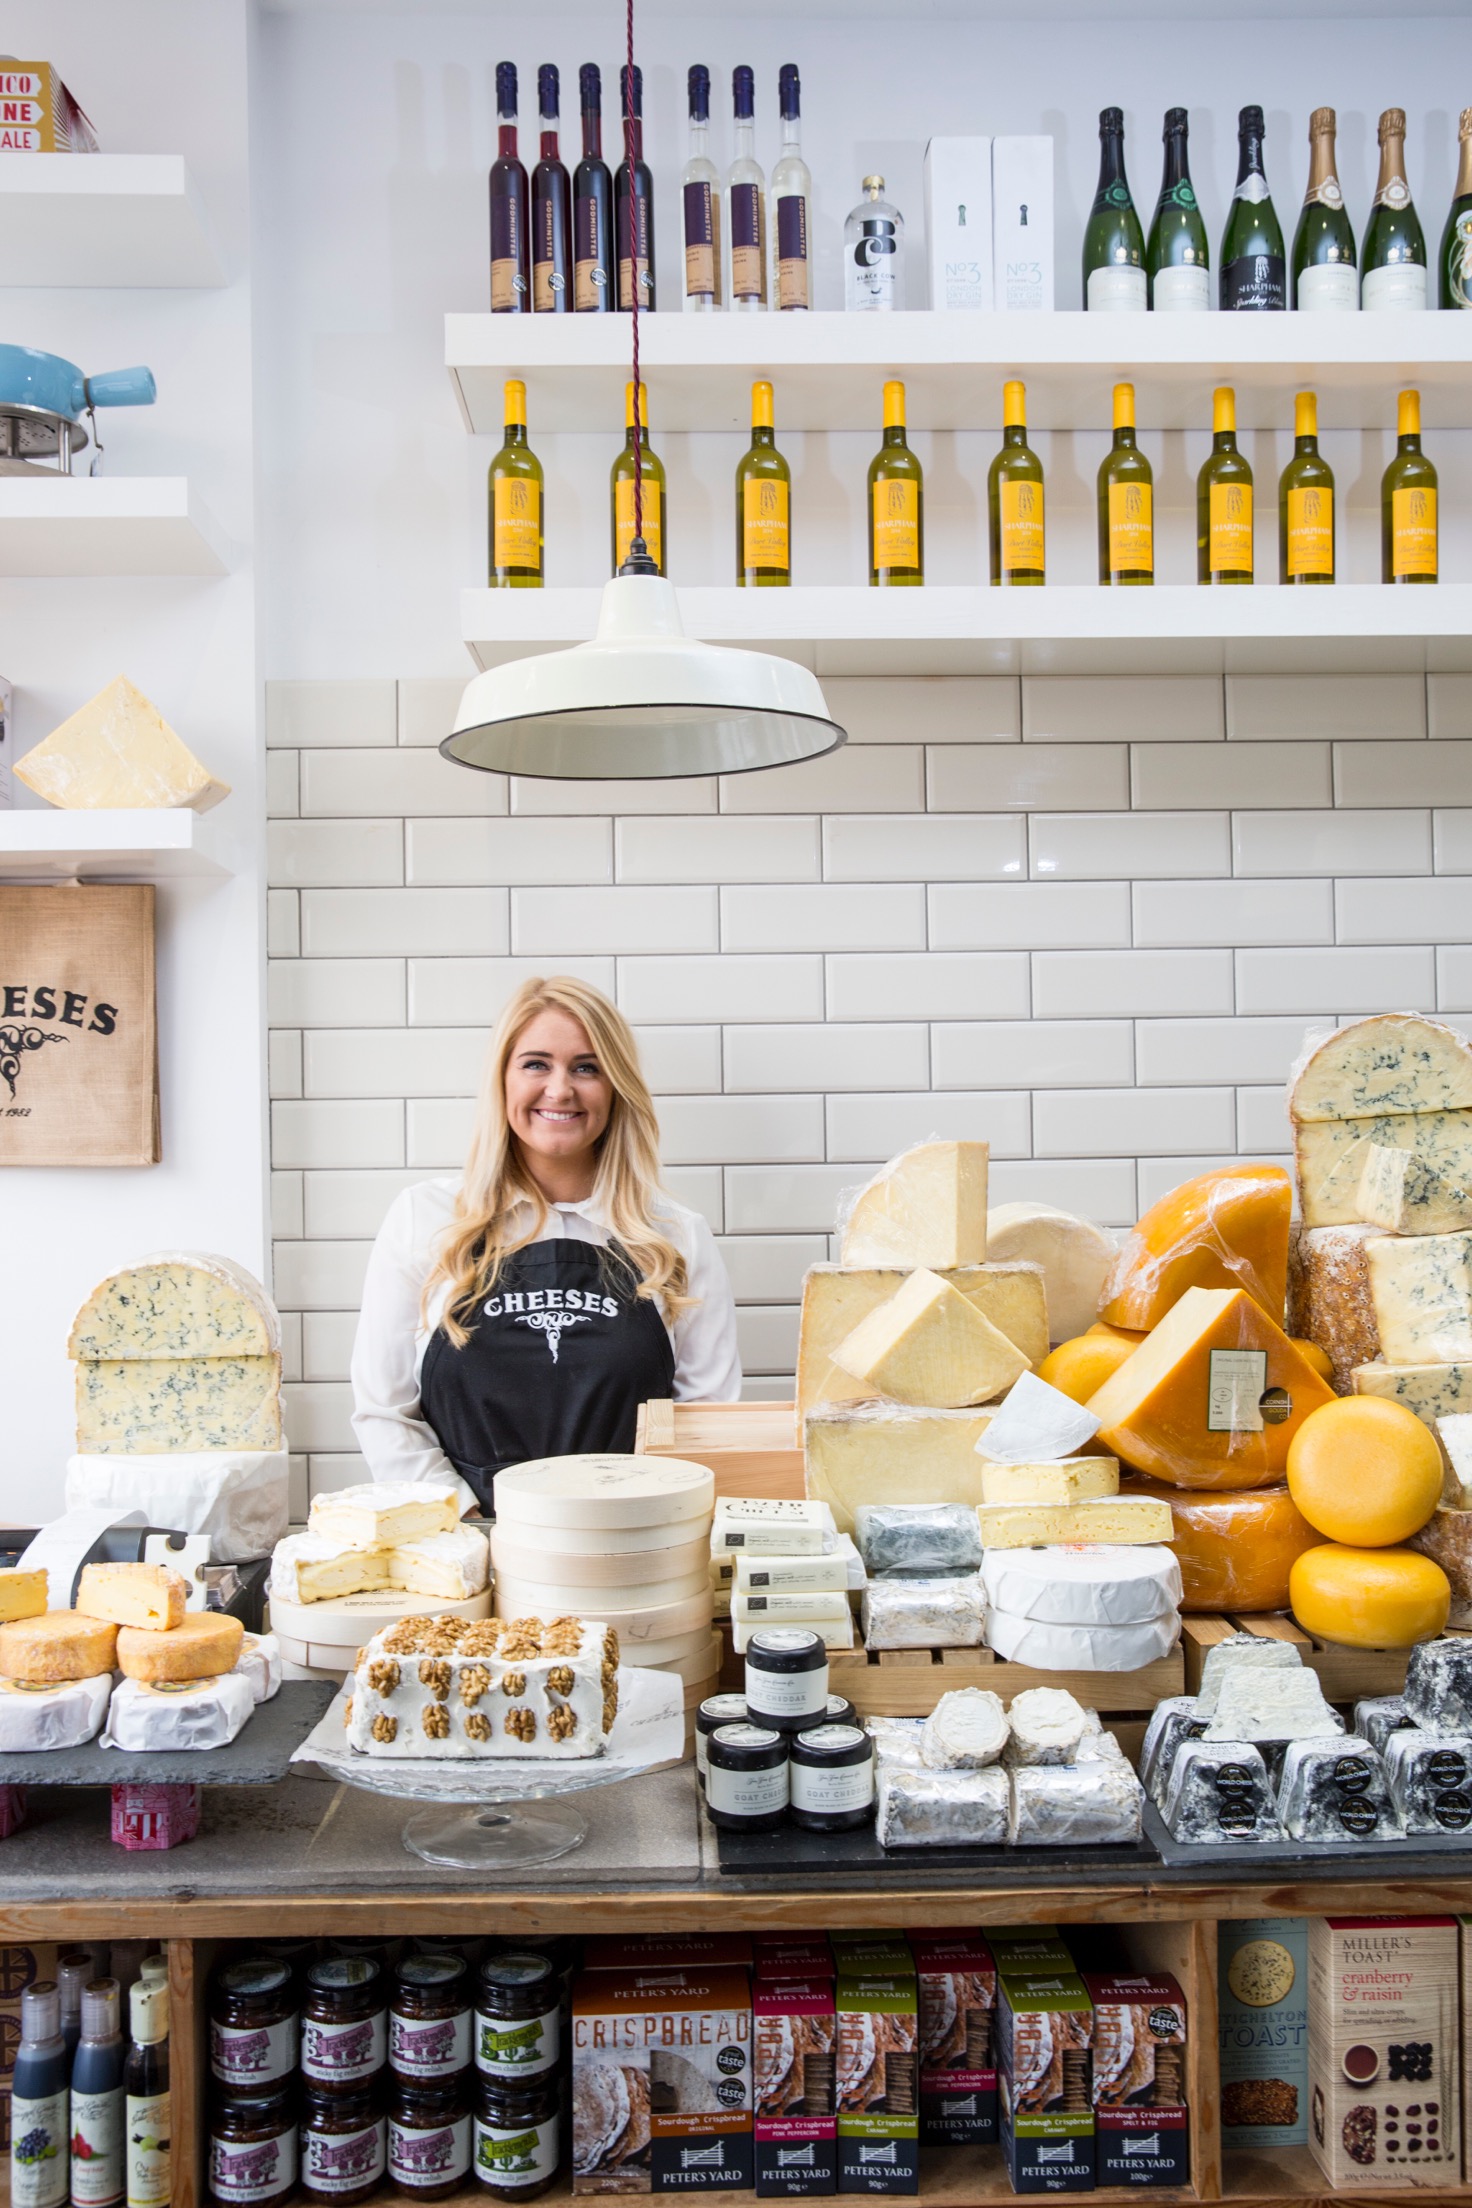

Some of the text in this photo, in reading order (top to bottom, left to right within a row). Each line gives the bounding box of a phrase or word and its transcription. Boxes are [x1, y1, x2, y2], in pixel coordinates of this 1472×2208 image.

[703, 184, 712, 241] GODMINSTER
[751, 186, 759, 243] GODMINSTER
[509, 197, 517, 255] GODMINSTER
[545, 200, 553, 258] GODMINSTER
[639, 198, 647, 255] GODMINSTER
[798, 198, 806, 255] GODMINSTER
[857, 272, 896, 281] BLACK COW
[1238, 282, 1281, 294] SHARPHAM
[496, 519, 538, 530] SHARPHAM
[746, 519, 787, 530] SHARPHAM
[876, 519, 917, 530] SHARPHAM
[1004, 521, 1043, 531] SHARPHAM
[1111, 523, 1151, 532] SHARPHAM
[1212, 523, 1252, 533] SHARPHAM
[1289, 527, 1331, 538] SHARPHAM
[1396, 528, 1436, 538] SHARPHAM
[1, 985, 119, 1036] ESES
[483, 1288, 619, 1318] CHEESES
[766, 1694, 807, 1702] CHEDDAR
[806, 1784, 870, 1798] GOAT CHEDDAR
[623, 1942, 714, 1952] PETER'S YARD
[1342, 1937, 1412, 1950] MILLER'S
[1342, 1969, 1413, 1988] cranberry
[614, 1987, 710, 1998] PETER'S YARD
[1342, 1987, 1403, 2001] & raisin
[1149, 2017, 1179, 2030] taste
[406, 2025, 451, 2047] Tracklements
[495, 2024, 539, 2048] Tracklements
[574, 2013, 749, 2049] CRISPBREAD
[1218, 2024, 1306, 2048] TOAST
[326, 2026, 369, 2053] Tracklements
[718, 2055, 745, 2067] taste
[316, 2067, 362, 2079] sticky fig relish
[397, 2062, 443, 2074] sticky fig relish
[486, 2063, 534, 2073] green chilli jam
[227, 2071, 257, 2081] fig relish
[958, 2073, 995, 2081] Crispbread
[718, 2087, 745, 2100] taste
[657, 2114, 746, 2126] Sourdough Crispbread
[1098, 2111, 1182, 2120] Sourdough Crispbread
[757, 2120, 835, 2130] Sourdough Crispbread
[839, 2119, 916, 2128] Sourdough Crispbread
[927, 2119, 992, 2129] PETER'S YARD
[1017, 2117, 1093, 2128] Sourdough Crispbread
[330, 2133, 374, 2163] Tracklements
[405, 2133, 449, 2157] Tracklements
[491, 2133, 535, 2158] Tracklements
[229, 2145, 274, 2173] Tracklements
[1107, 2158, 1176, 2169] PETER'S YARD
[397, 2171, 442, 2183] sticky fig relish
[482, 2171, 529, 2182] green chilli jam
[663, 2170, 742, 2183] PETER'S YARD
[762, 2168, 831, 2179] PETER'S YARD
[844, 2166, 913, 2177] PETER'S YARD
[1022, 2166, 1090, 2176] PETER'S YARD
[320, 2175, 368, 2189] sticky fig relish
[1130, 2173, 1148, 2182] 100g
[787, 2183, 801, 2192] 90g
[868, 2180, 882, 2189] 90g
[1046, 2180, 1060, 2189] 90g
[235, 2188, 246, 2199] fig
[246, 2188, 266, 2197] relish
